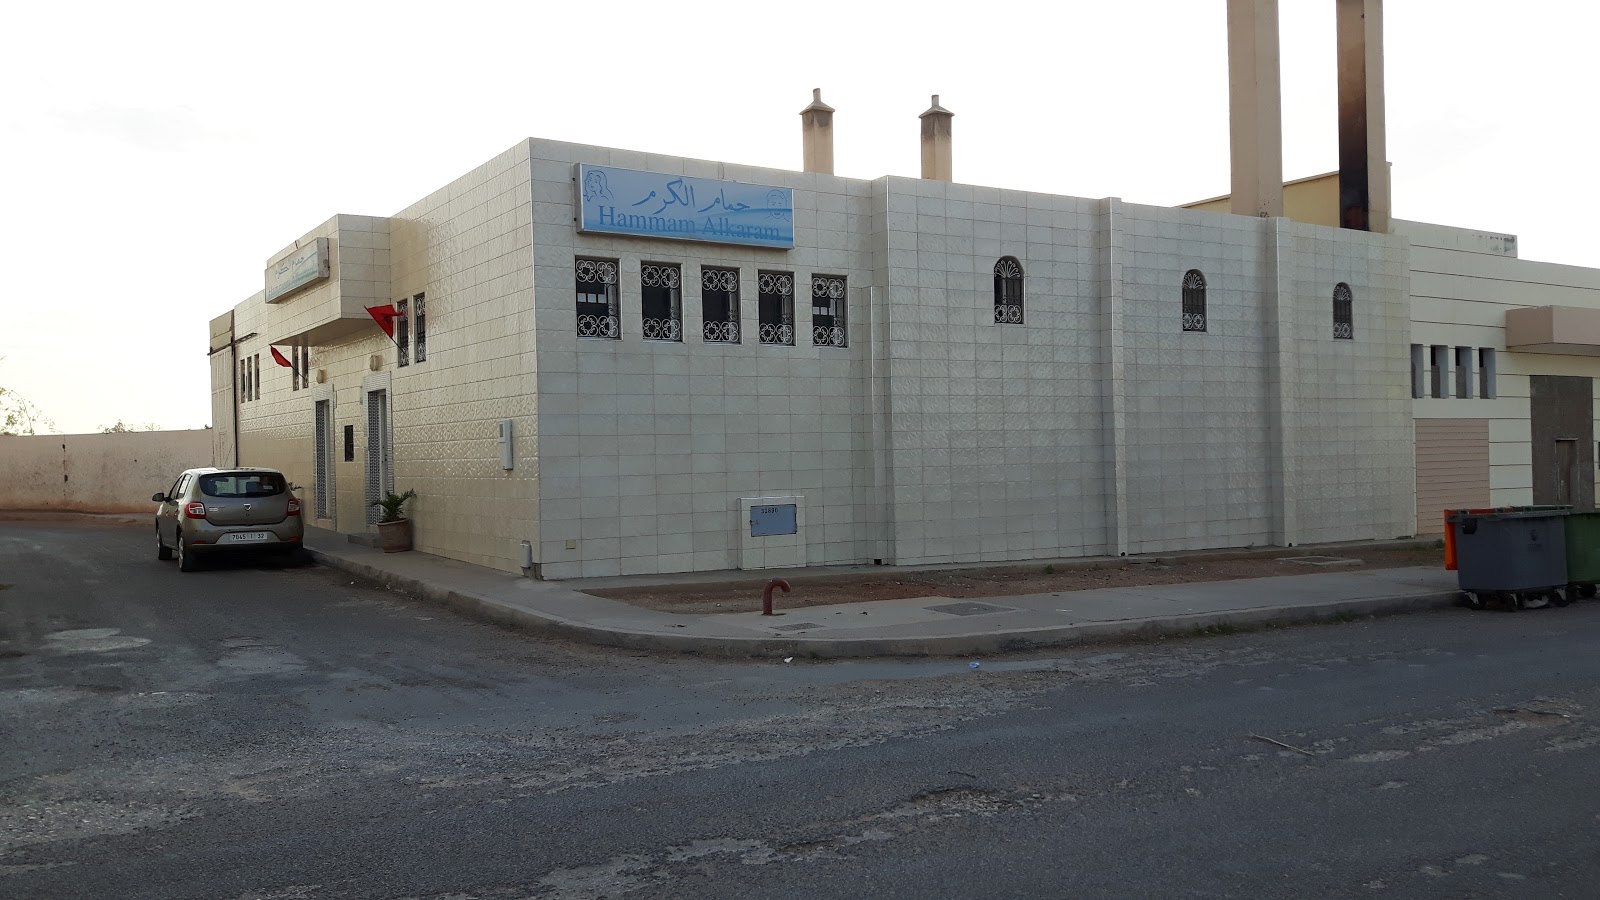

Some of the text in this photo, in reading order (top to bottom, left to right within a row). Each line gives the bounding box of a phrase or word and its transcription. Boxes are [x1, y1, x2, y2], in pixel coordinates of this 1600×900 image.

[632, 177, 751, 215] حمام الكرم
[598, 205, 780, 241] Hammam Alkaram
